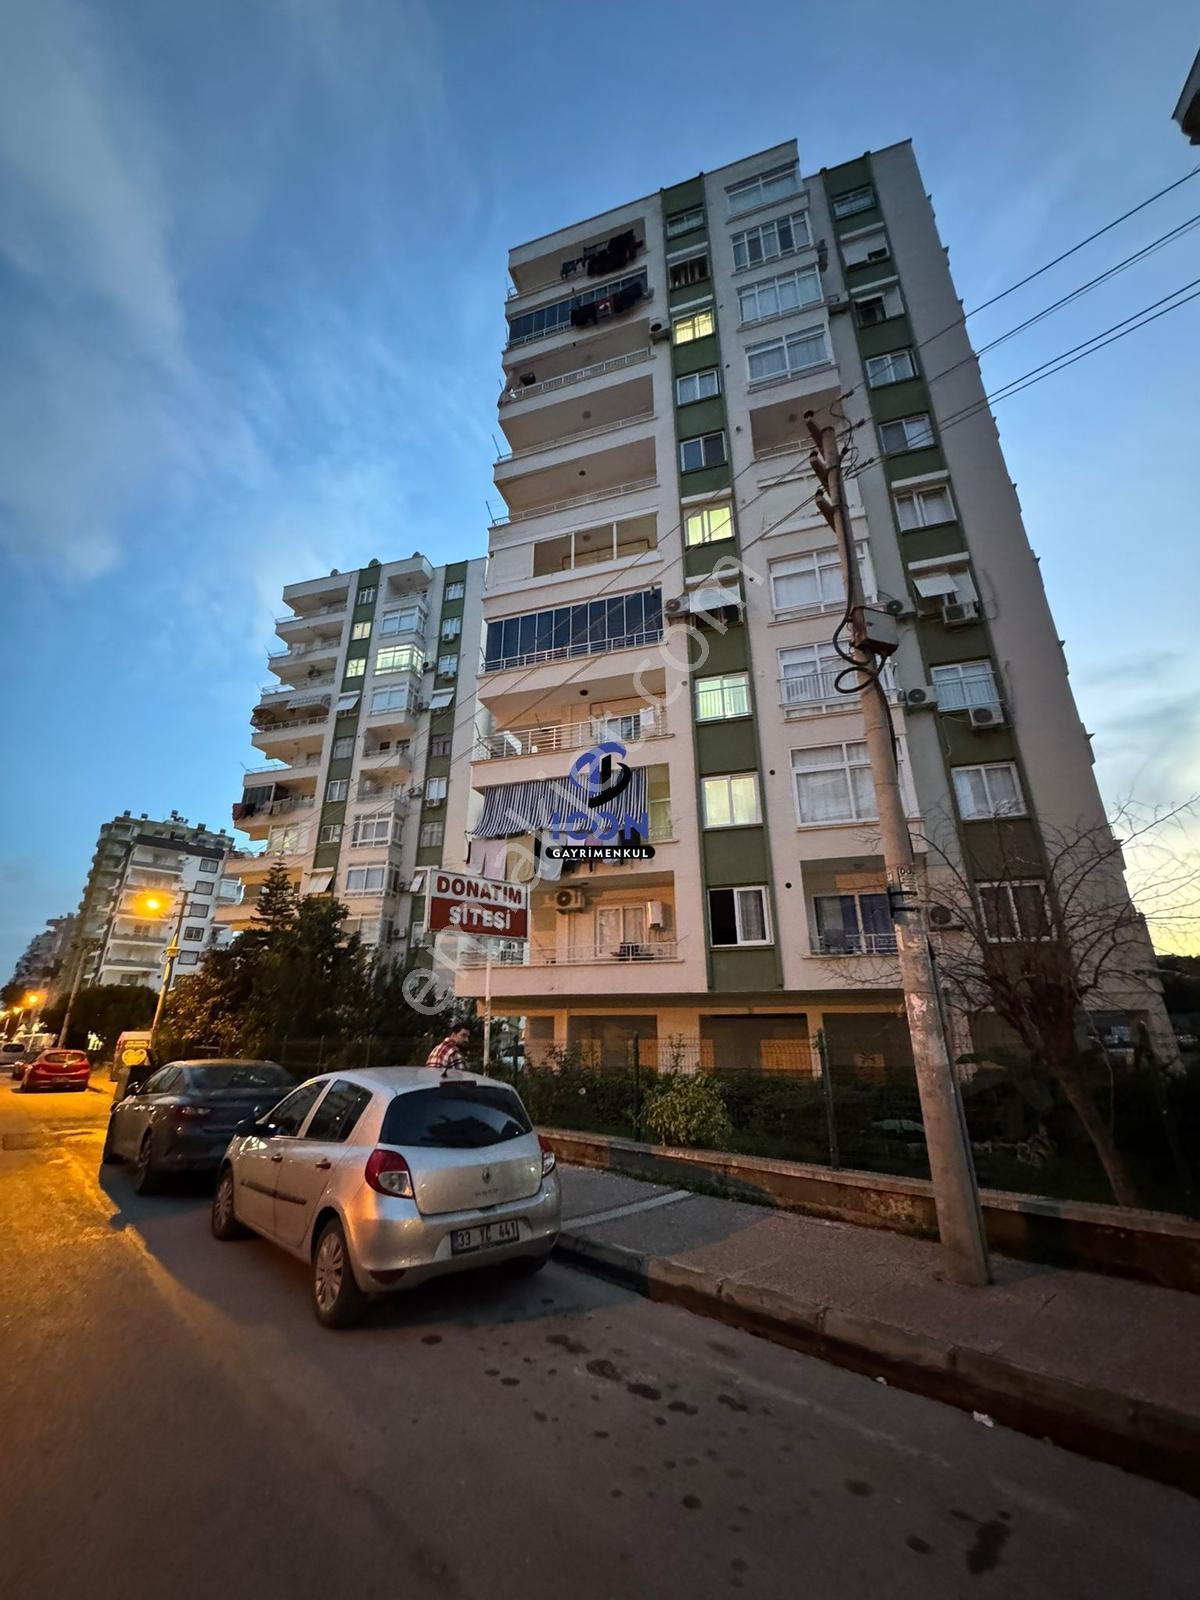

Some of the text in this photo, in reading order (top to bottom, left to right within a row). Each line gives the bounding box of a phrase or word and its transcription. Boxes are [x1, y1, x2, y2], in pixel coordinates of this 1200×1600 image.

[436, 875, 522, 905] DONATIM
[449, 904, 511, 930] SİTESİ
[458, 1231, 471, 1247] 33
